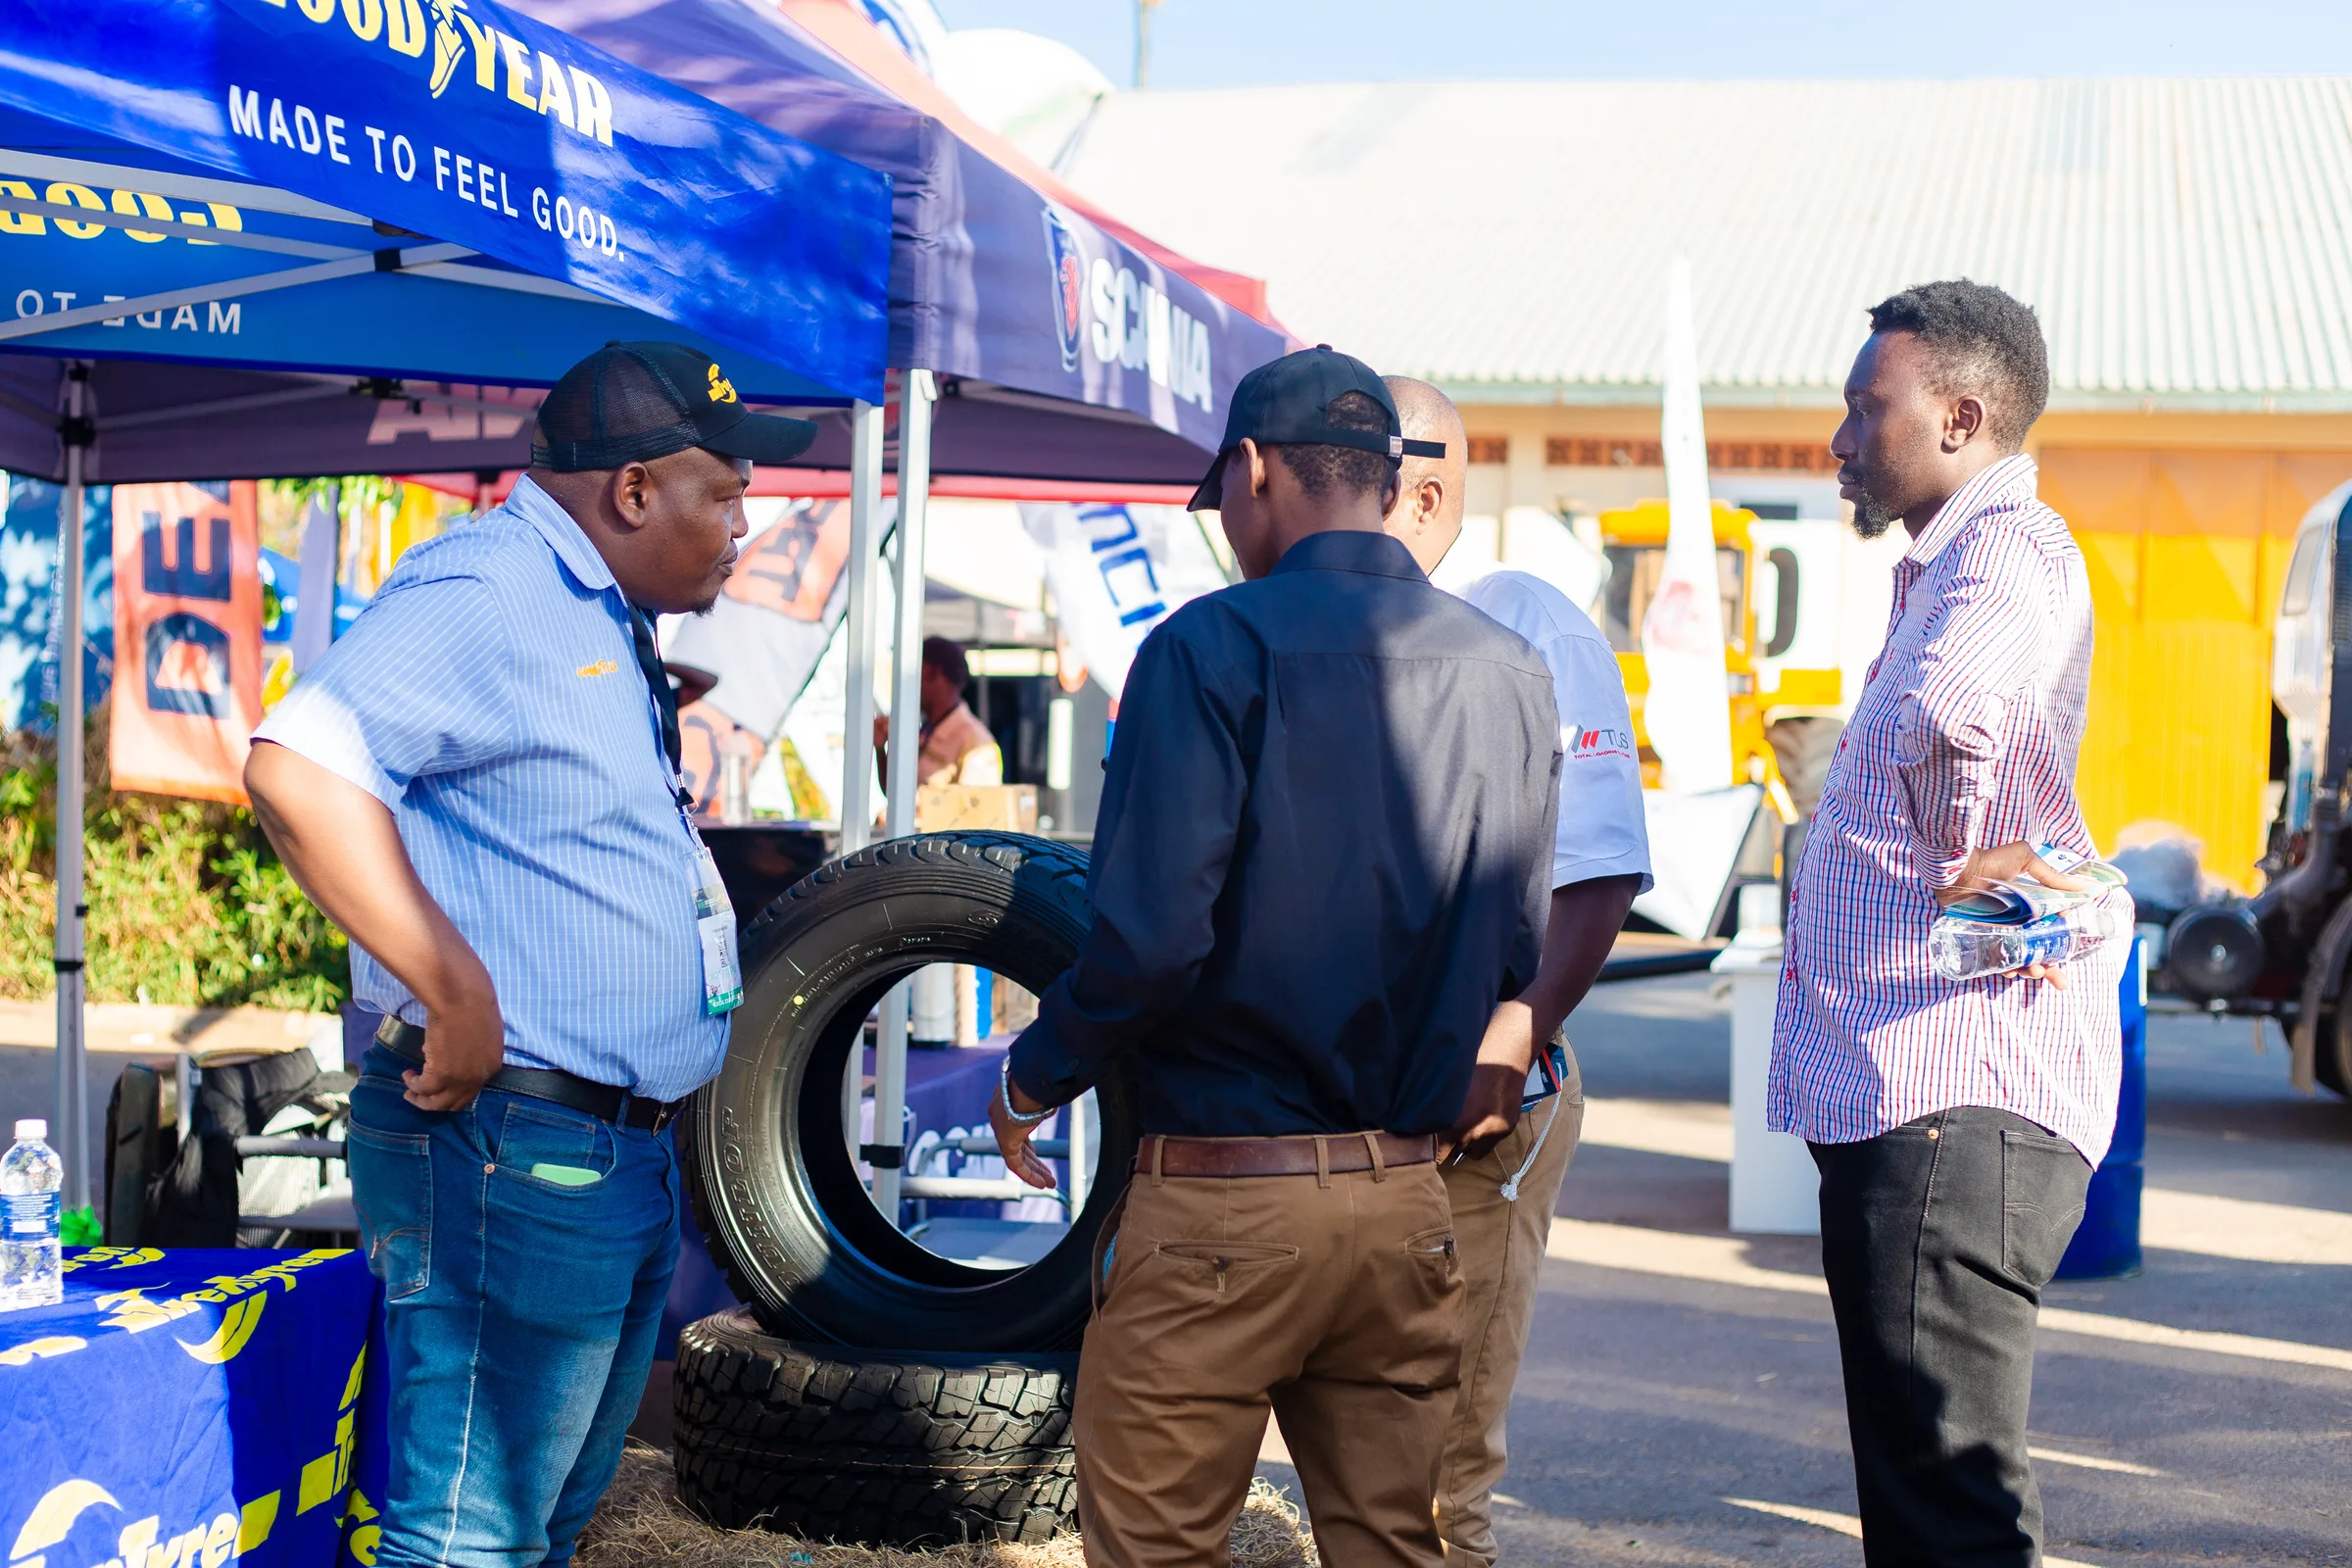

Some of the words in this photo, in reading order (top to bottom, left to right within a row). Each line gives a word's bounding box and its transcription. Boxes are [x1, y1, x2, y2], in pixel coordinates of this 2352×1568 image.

[261, 0, 613, 147] ODYEAR
[228, 84, 351, 165] MADE
[366, 125, 416, 182] TO
[433, 146, 519, 218] FEEL
[532, 186, 625, 263] GOOD.
[1090, 257, 1213, 415] SCANIA
[142, 480, 231, 719] DE
